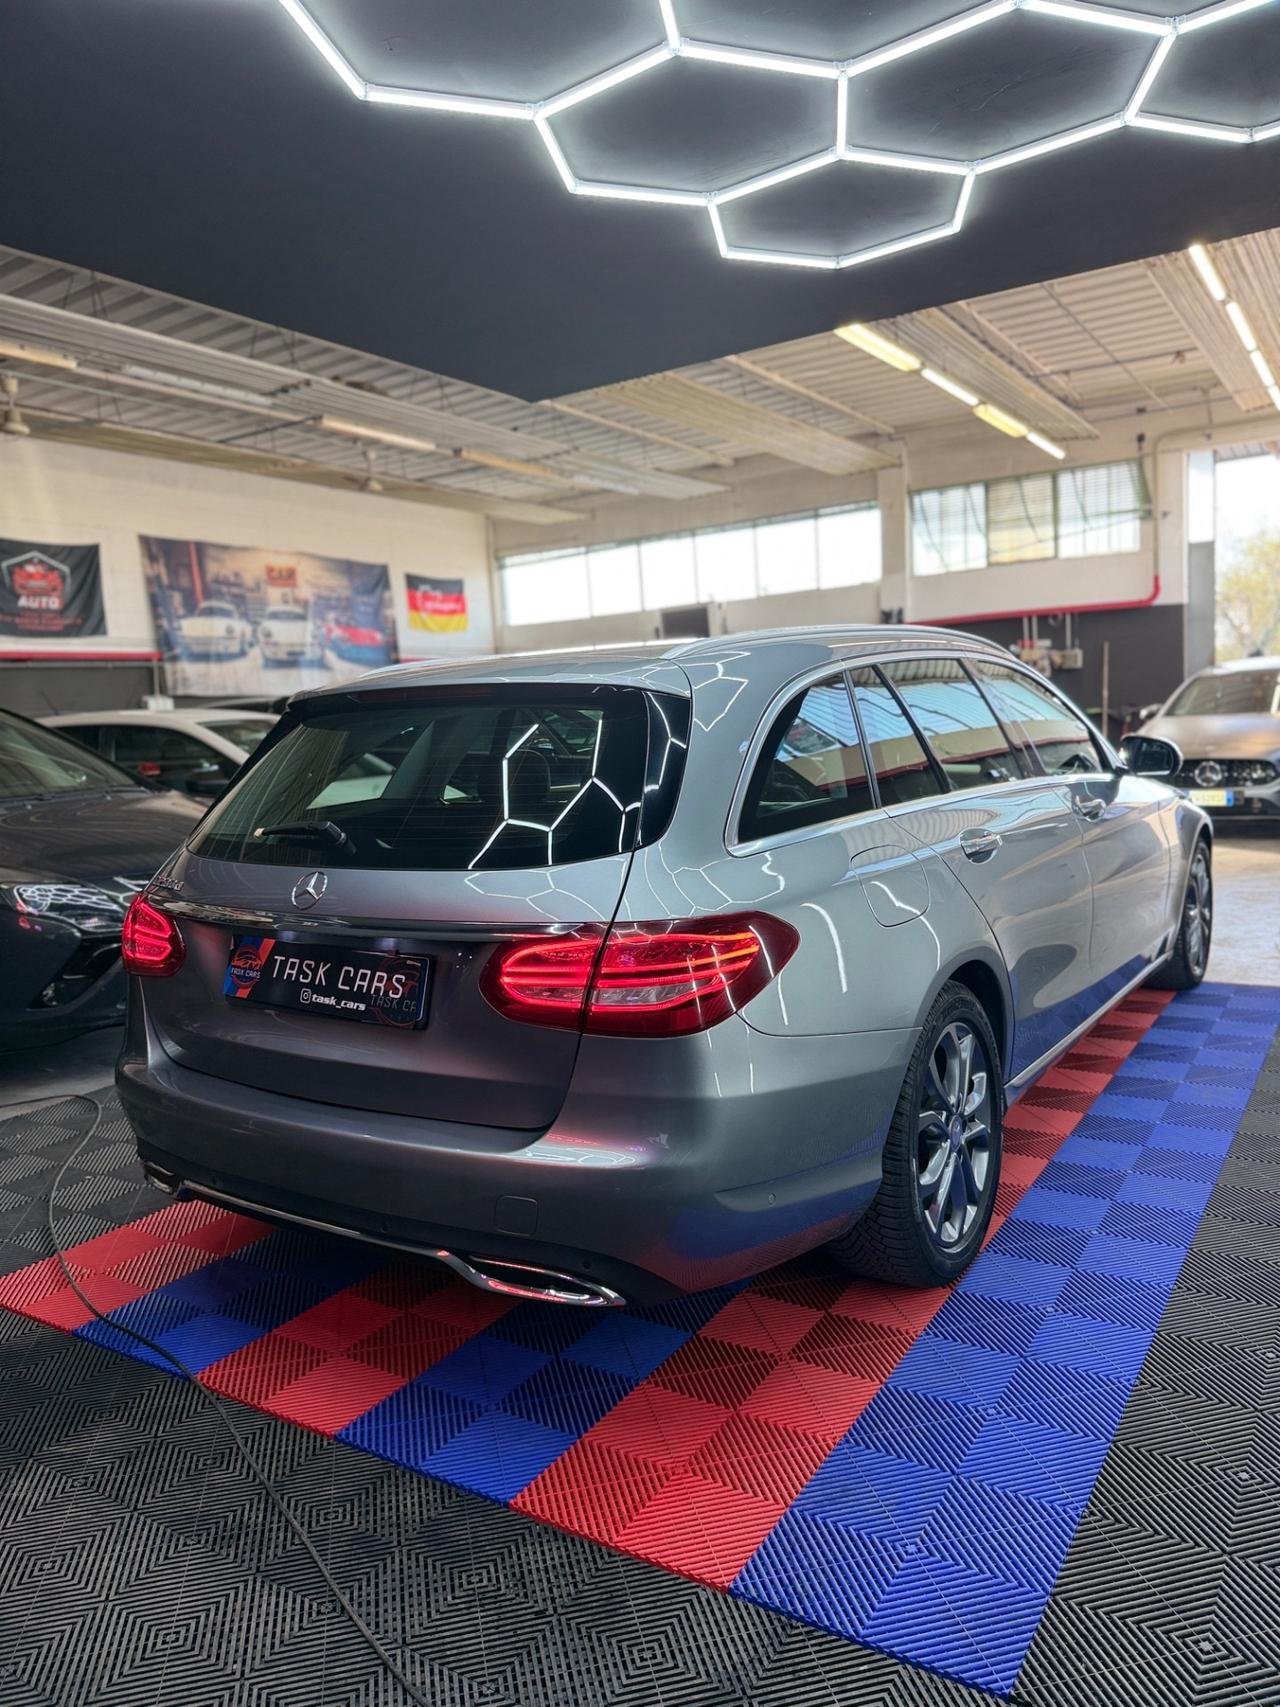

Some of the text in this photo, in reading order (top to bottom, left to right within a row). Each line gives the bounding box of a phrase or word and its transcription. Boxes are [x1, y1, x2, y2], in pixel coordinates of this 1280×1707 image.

[17, 595, 62, 610] AUTO
[231, 967, 260, 979] TASK CARS
[272, 955, 406, 999] TASK CARS
[311, 993, 367, 1011] task_cars
[370, 994, 399, 1009] TASK
